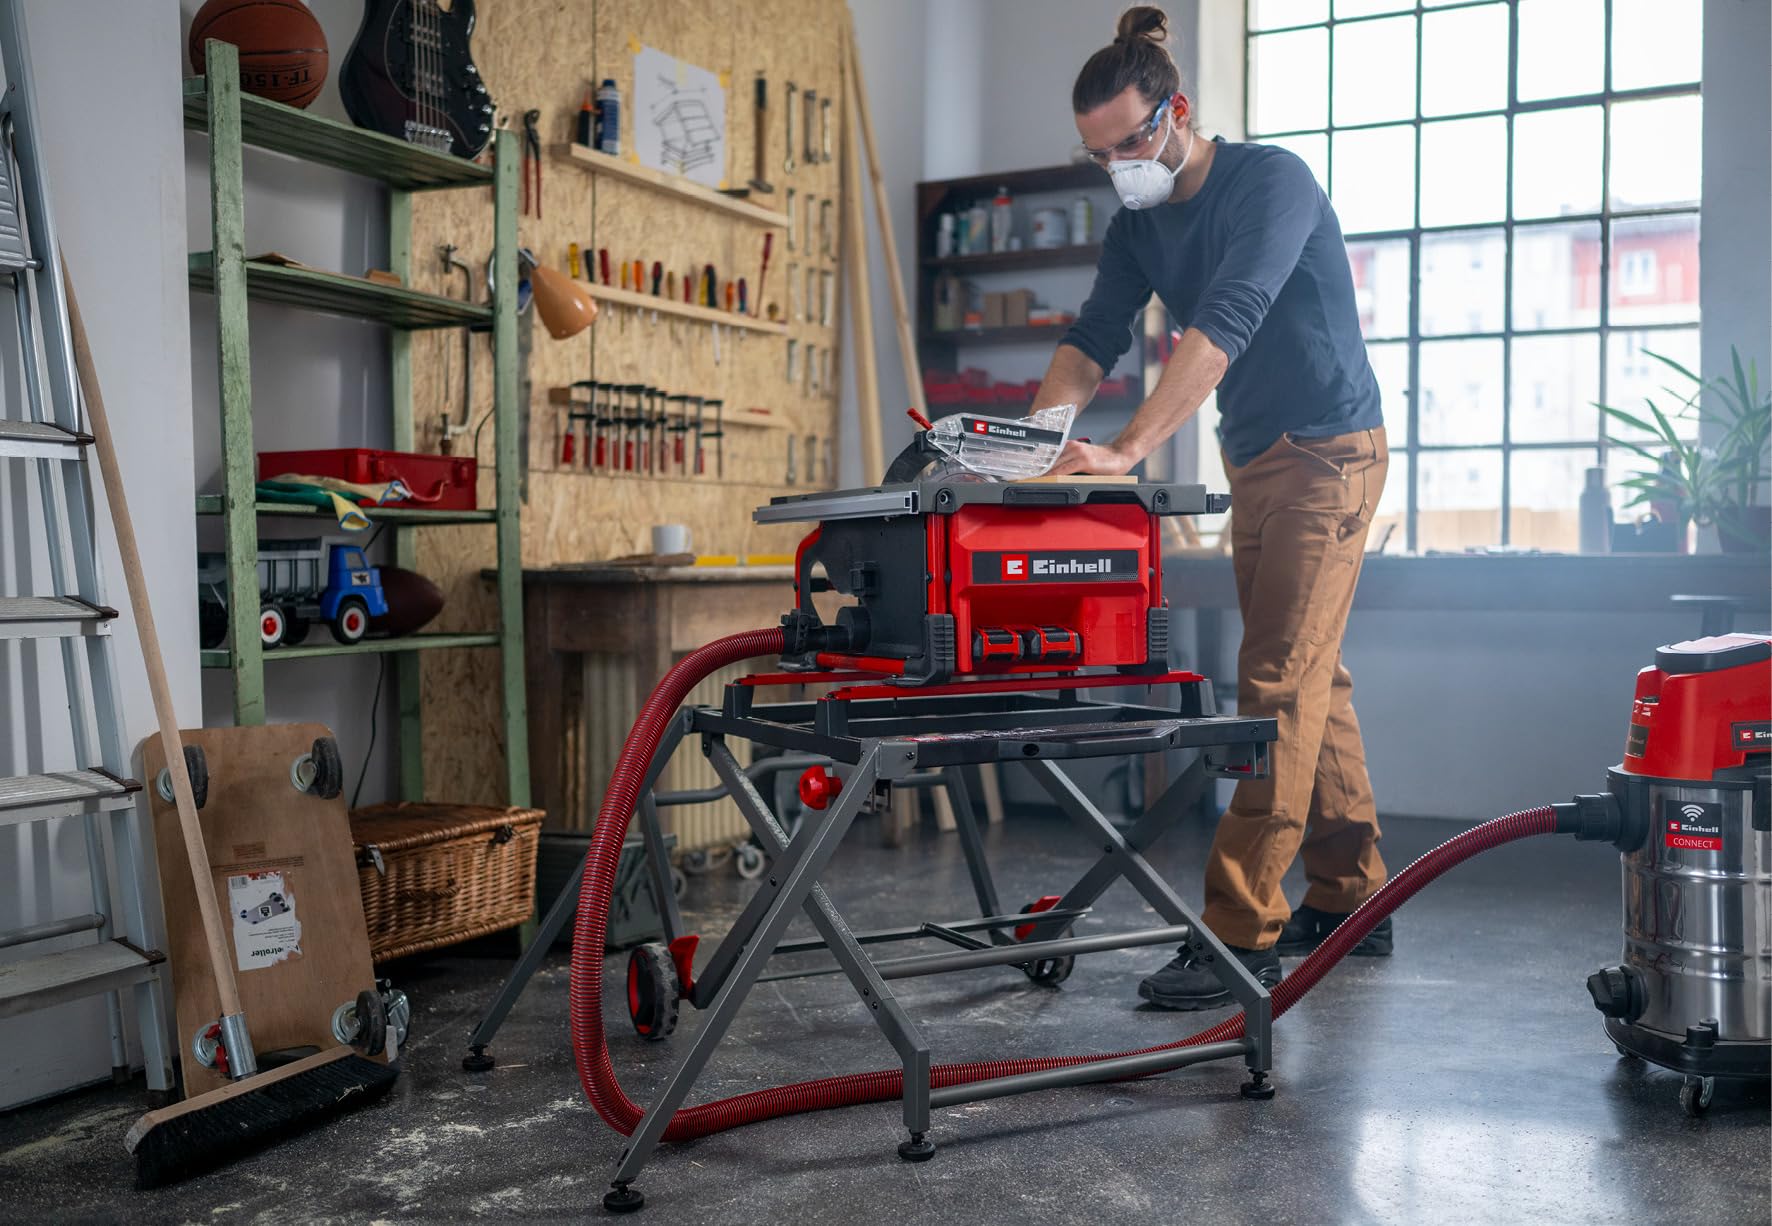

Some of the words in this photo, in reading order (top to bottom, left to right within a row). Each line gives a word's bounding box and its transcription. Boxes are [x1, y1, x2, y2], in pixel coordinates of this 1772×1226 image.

[988, 425, 1026, 437] Einhell
[1033, 558, 1111, 574] Einhell
[1681, 824, 1719, 833] Einhell
[1673, 838, 1713, 848] CONNECT
